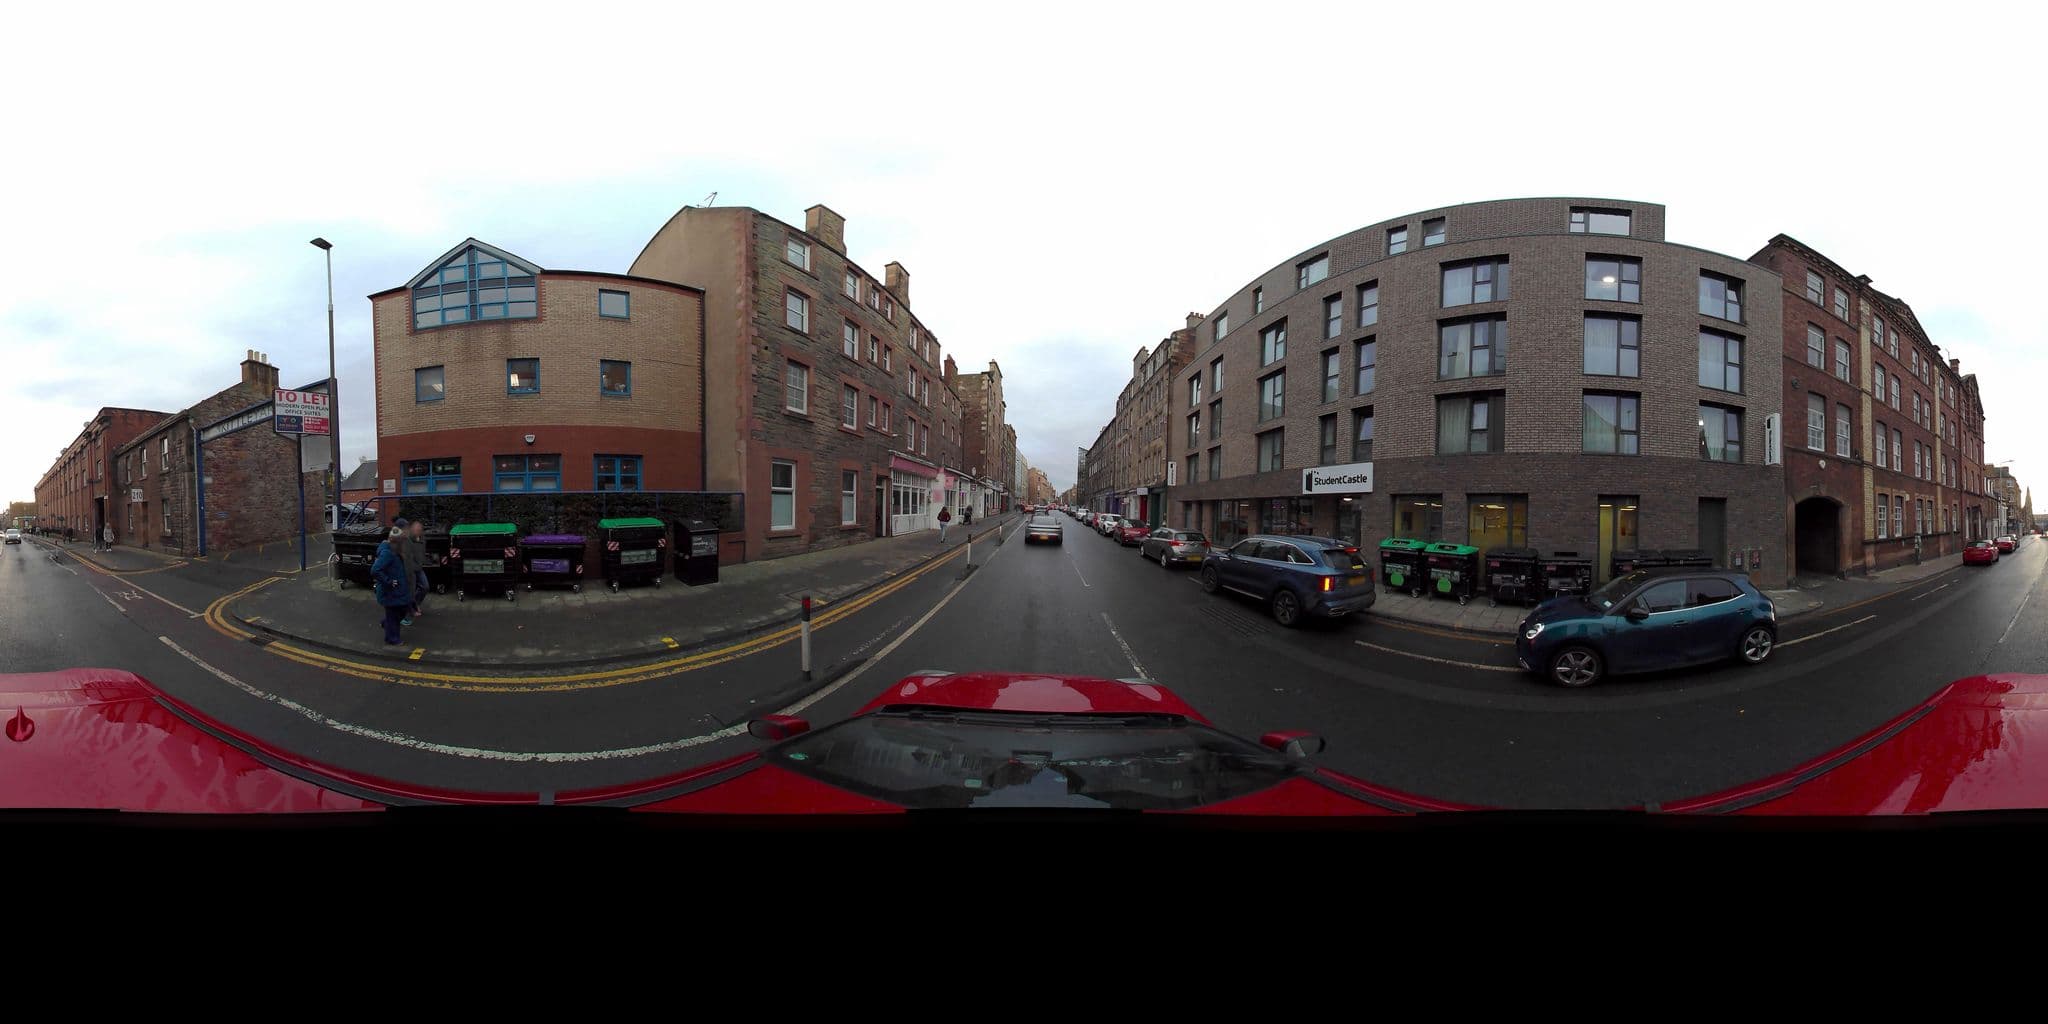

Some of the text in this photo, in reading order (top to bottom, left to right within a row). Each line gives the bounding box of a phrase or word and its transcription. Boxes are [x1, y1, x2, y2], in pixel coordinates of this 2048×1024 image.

[276, 391, 328, 406] TO LET
[1314, 474, 1368, 485] StudentCastle
